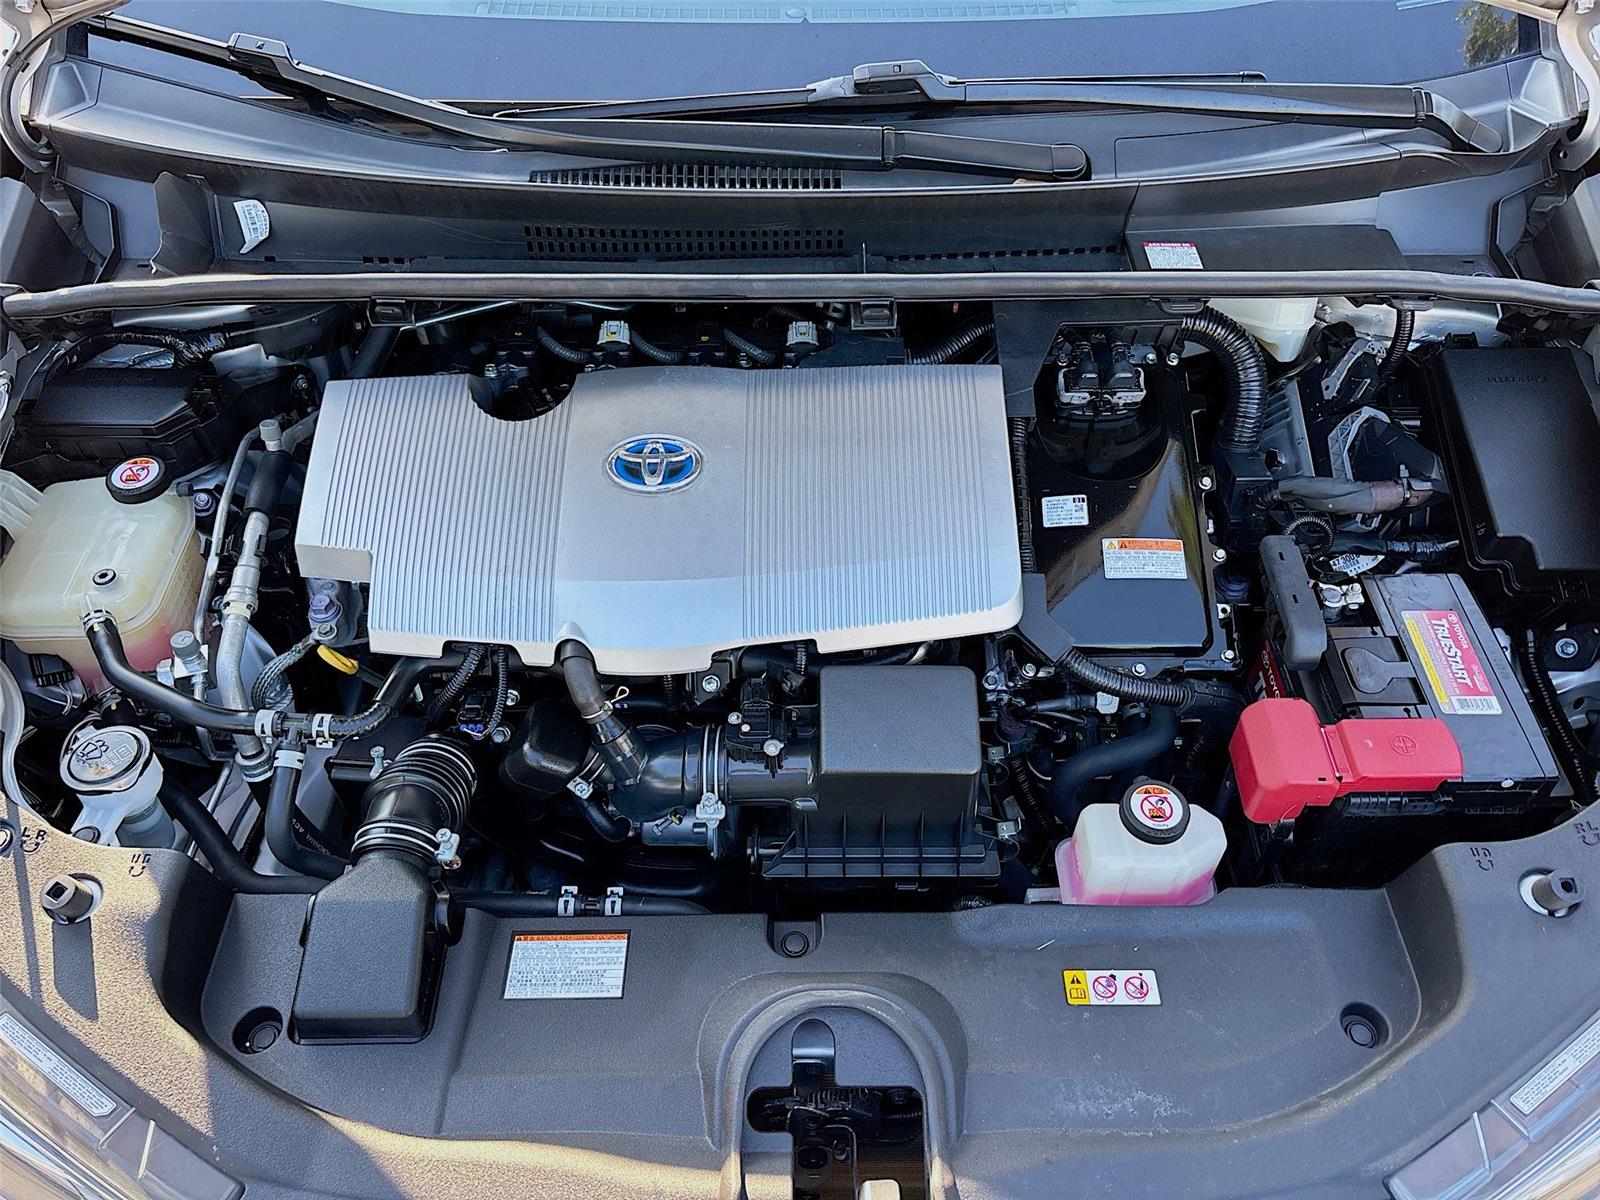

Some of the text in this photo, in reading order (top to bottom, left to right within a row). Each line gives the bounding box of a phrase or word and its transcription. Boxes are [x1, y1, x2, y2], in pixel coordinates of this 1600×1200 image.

[1452, 622, 1469, 649] TOYOTA
[1430, 618, 1473, 689] TRUESTART
[1267, 666, 1280, 699] TOYO
